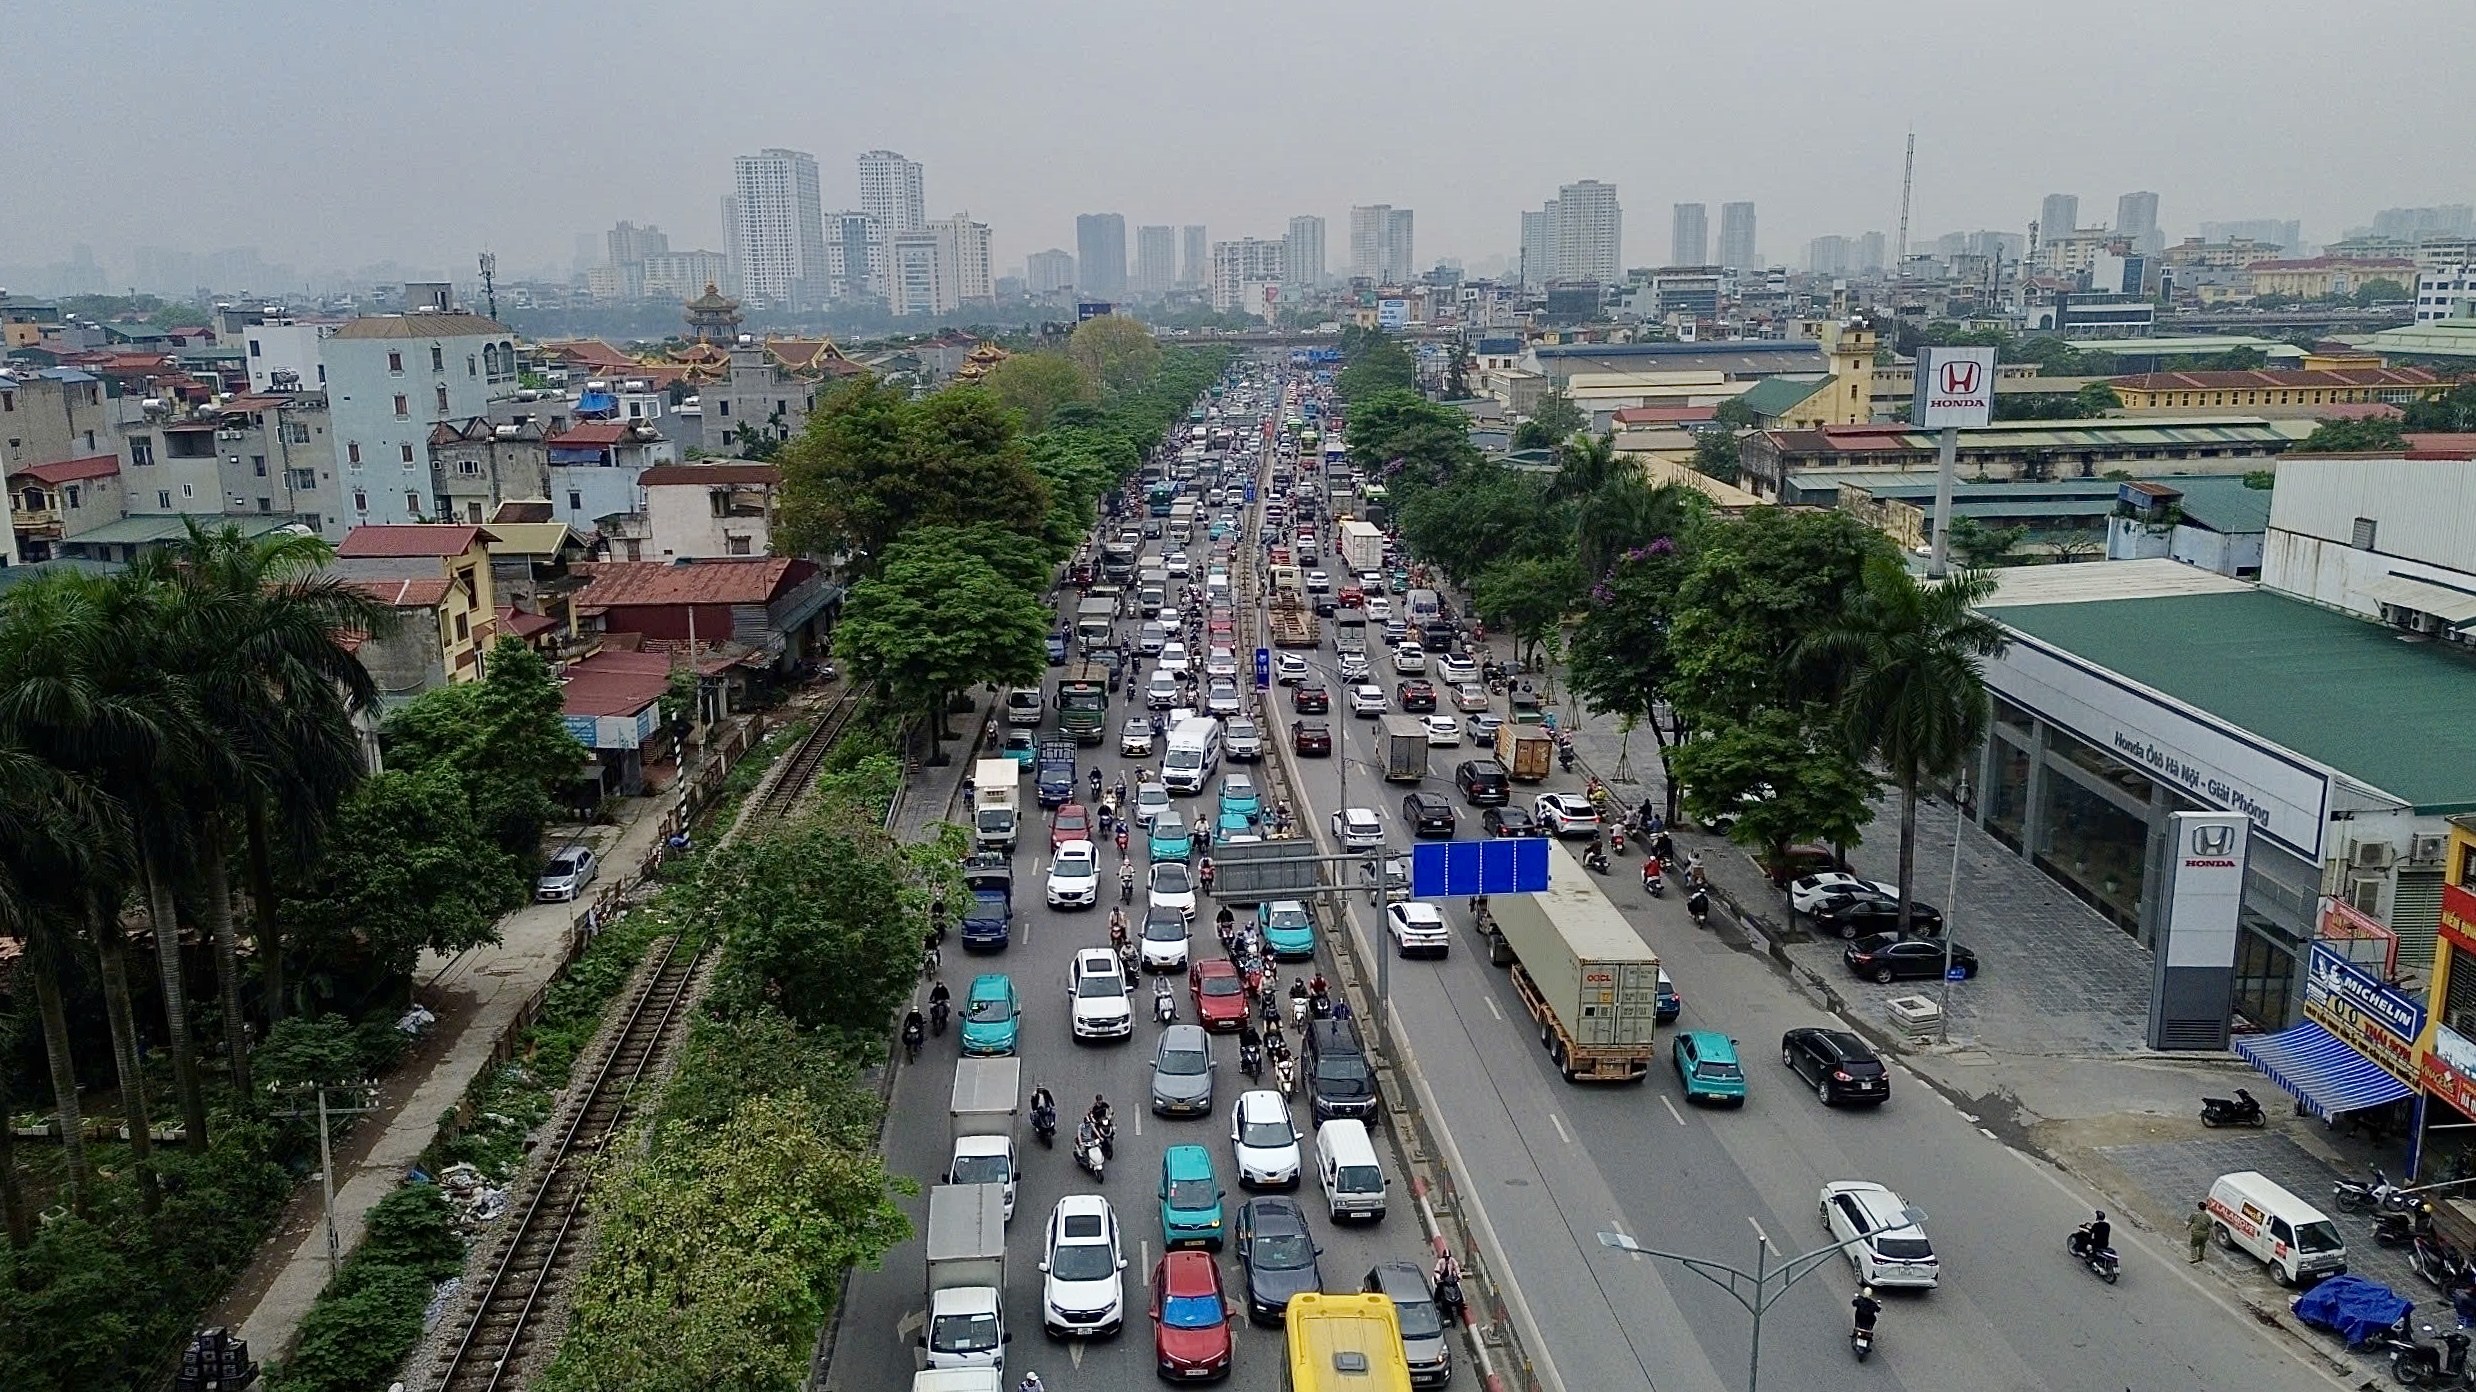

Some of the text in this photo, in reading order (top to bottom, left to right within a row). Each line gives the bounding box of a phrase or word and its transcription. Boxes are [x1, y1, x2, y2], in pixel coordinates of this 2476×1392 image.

[1930, 399, 1986, 409] HONDA
[2114, 730, 2144, 760] Honda
[2165, 756, 2179, 777] Hà
[2181, 764, 2199, 789] Nội
[2232, 789, 2270, 827] Phóng
[2184, 860, 2236, 868] HONDA
[1586, 974, 1612, 982] OOCL
[2343, 976, 2412, 1027] MICHELIN
[2216, 1203, 2256, 1234] LALAMOVE
